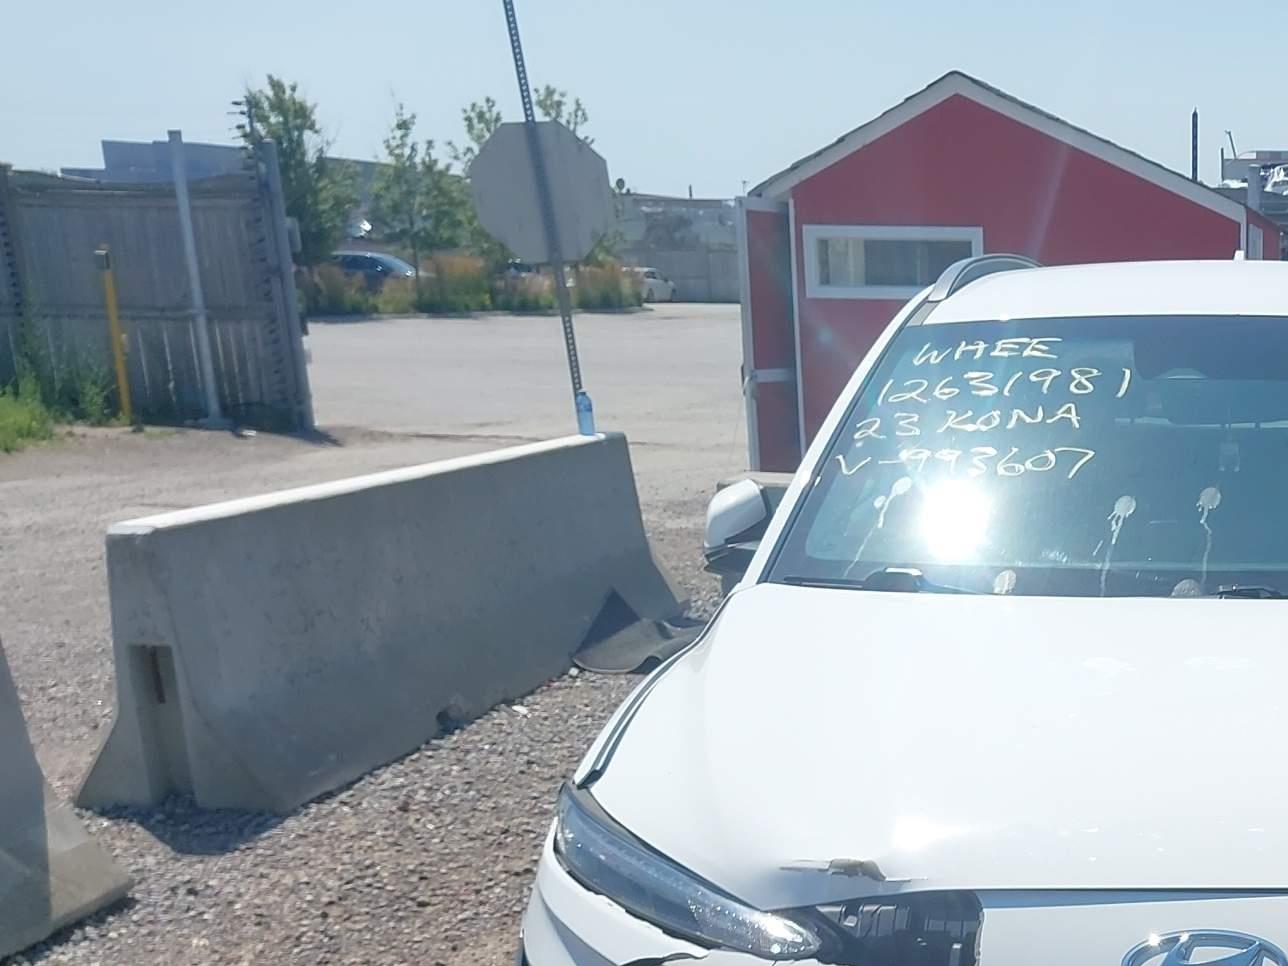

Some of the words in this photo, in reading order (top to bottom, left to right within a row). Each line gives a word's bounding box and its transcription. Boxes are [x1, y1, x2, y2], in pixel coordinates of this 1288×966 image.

[913, 338, 1062, 365] WHEE
[877, 367, 1132, 406] 12631981
[853, 413, 922, 440] 23
[937, 403, 1081, 433] KONA
